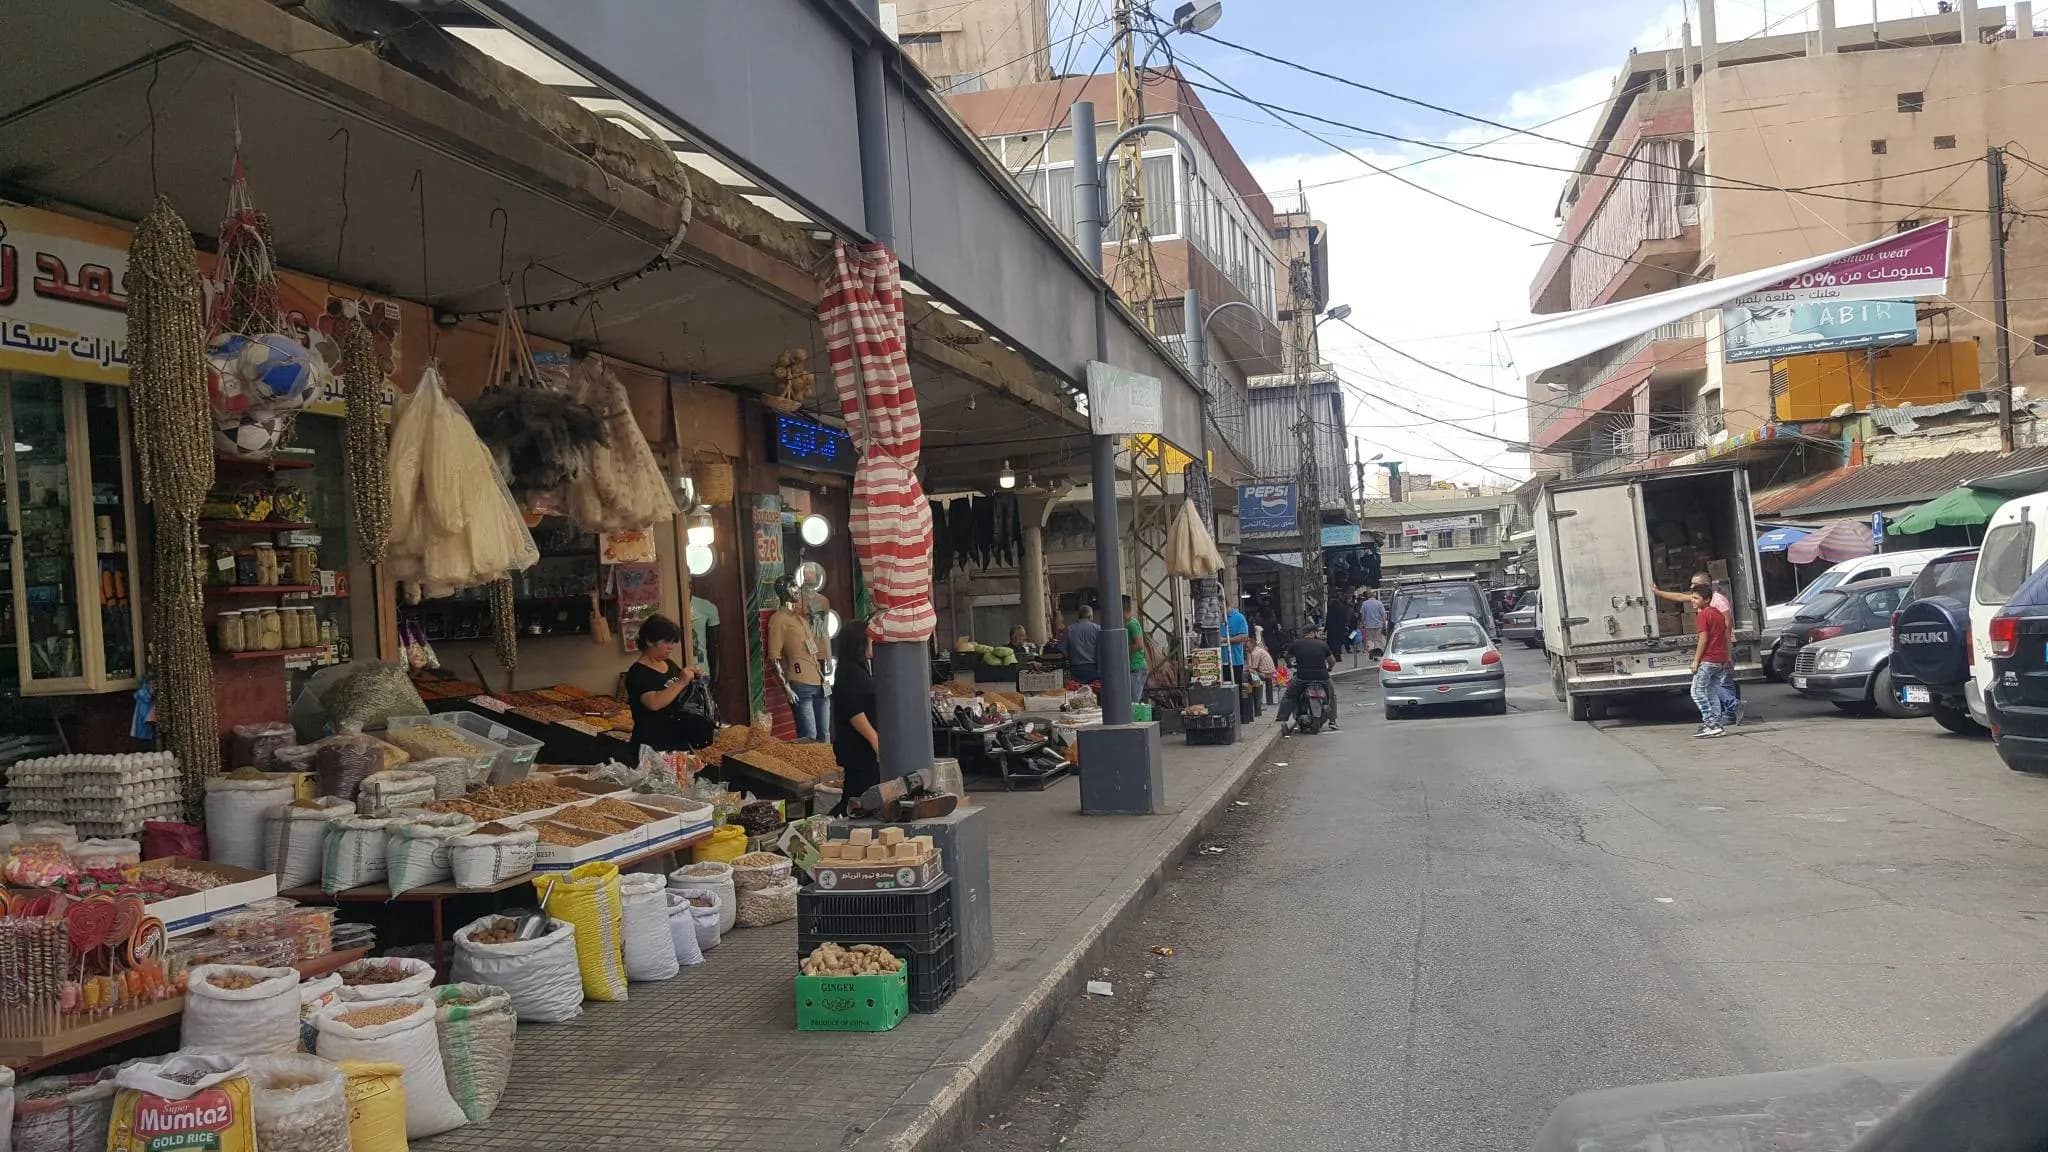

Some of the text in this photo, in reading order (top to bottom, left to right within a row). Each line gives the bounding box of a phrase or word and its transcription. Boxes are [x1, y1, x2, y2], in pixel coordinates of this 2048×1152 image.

[1877, 247, 1912, 260] wear
[1839, 270, 1862, 285] من
[1867, 264, 1934, 280] حسومات
[1788, 270, 1836, 290] 20%
[1765, 291, 1796, 303] طلعة
[1819, 301, 1892, 326] ABIR
[1244, 485, 1289, 499] PEPSI
[1899, 631, 1949, 644] SUZUKI
[820, 983, 856, 993] GINGER
[162, 1102, 190, 1115] Super
[140, 1105, 229, 1132] Mumtaz
[152, 1132, 214, 1149] GOLD RICE
